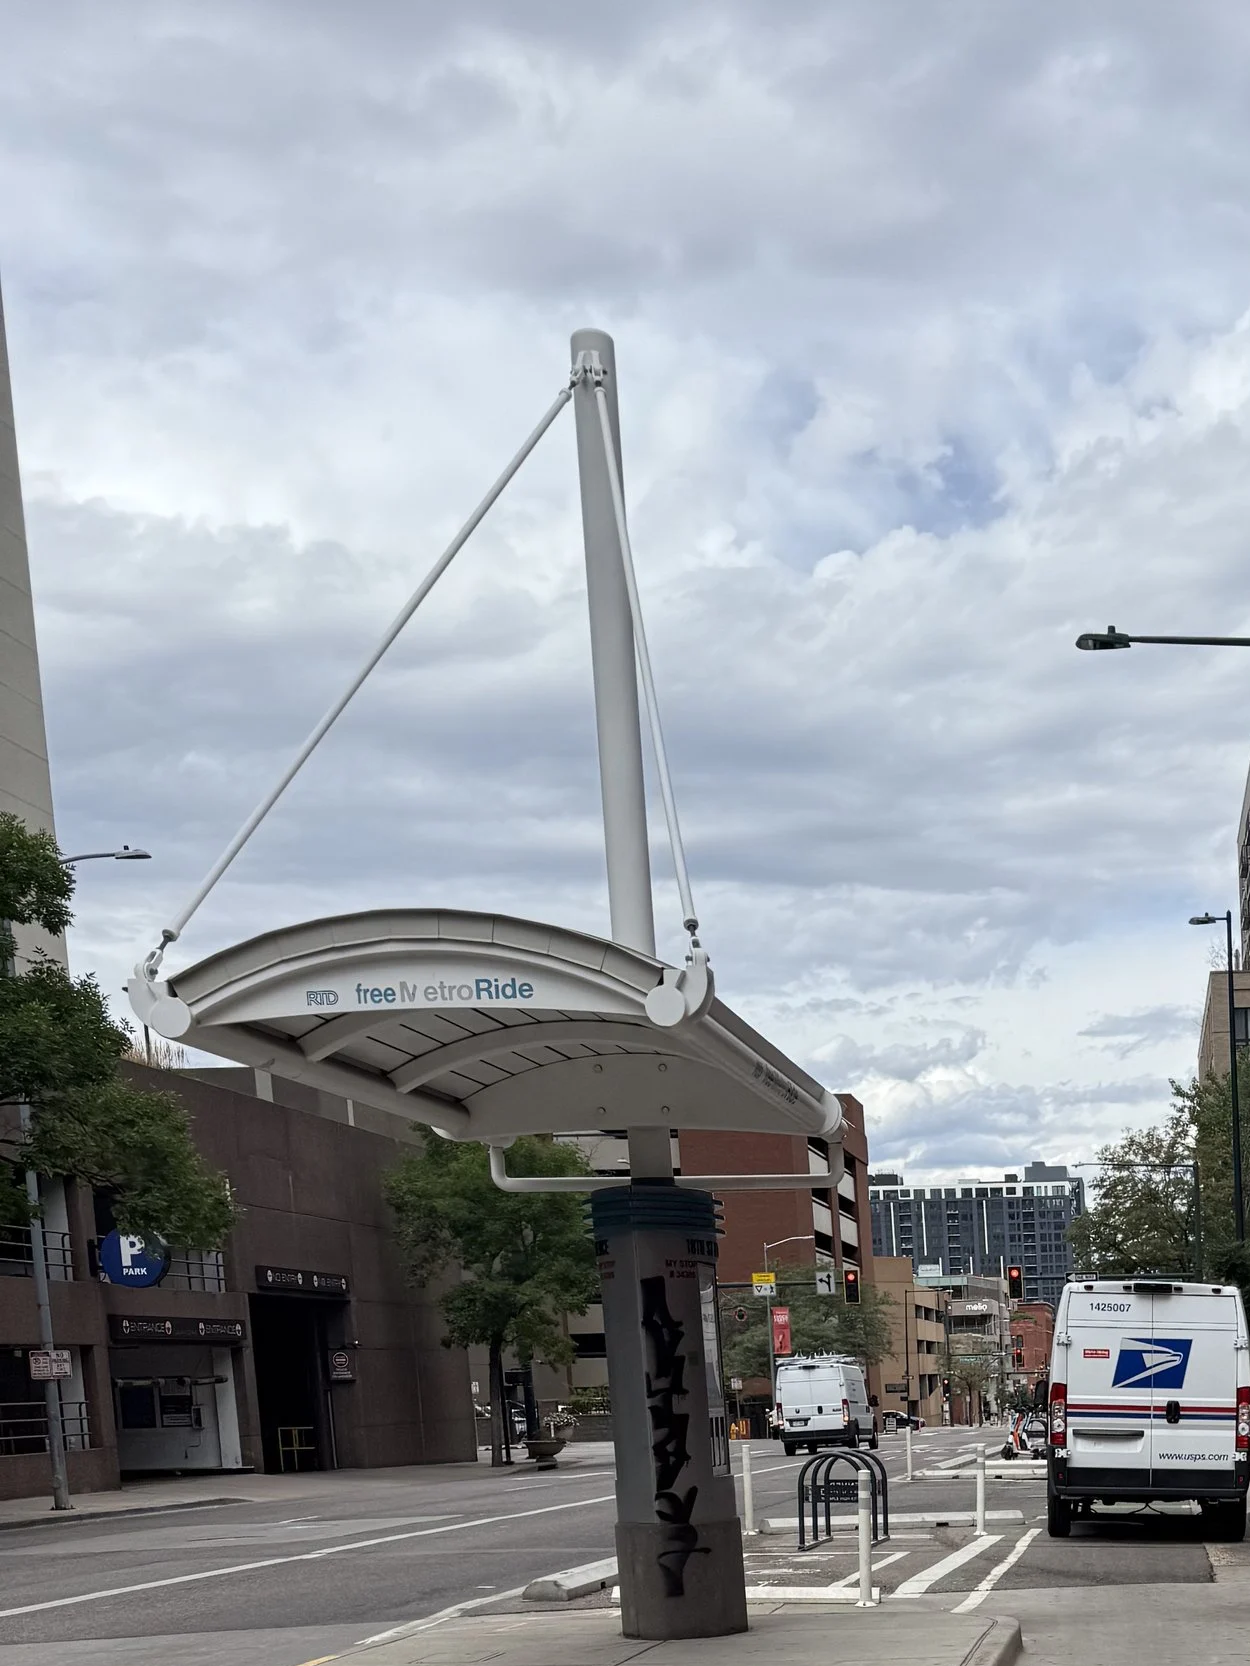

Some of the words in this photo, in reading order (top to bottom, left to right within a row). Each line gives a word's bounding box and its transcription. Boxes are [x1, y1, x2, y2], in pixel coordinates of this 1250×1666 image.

[306, 990, 339, 1006] RTD
[120, 1234, 146, 1266] P
[123, 1267, 147, 1276] PARK
[1089, 1302, 1131, 1313] 1425007
[130, 1322, 165, 1334] ENTRANCE
[1159, 1451, 1229, 1462] www.usps.com
